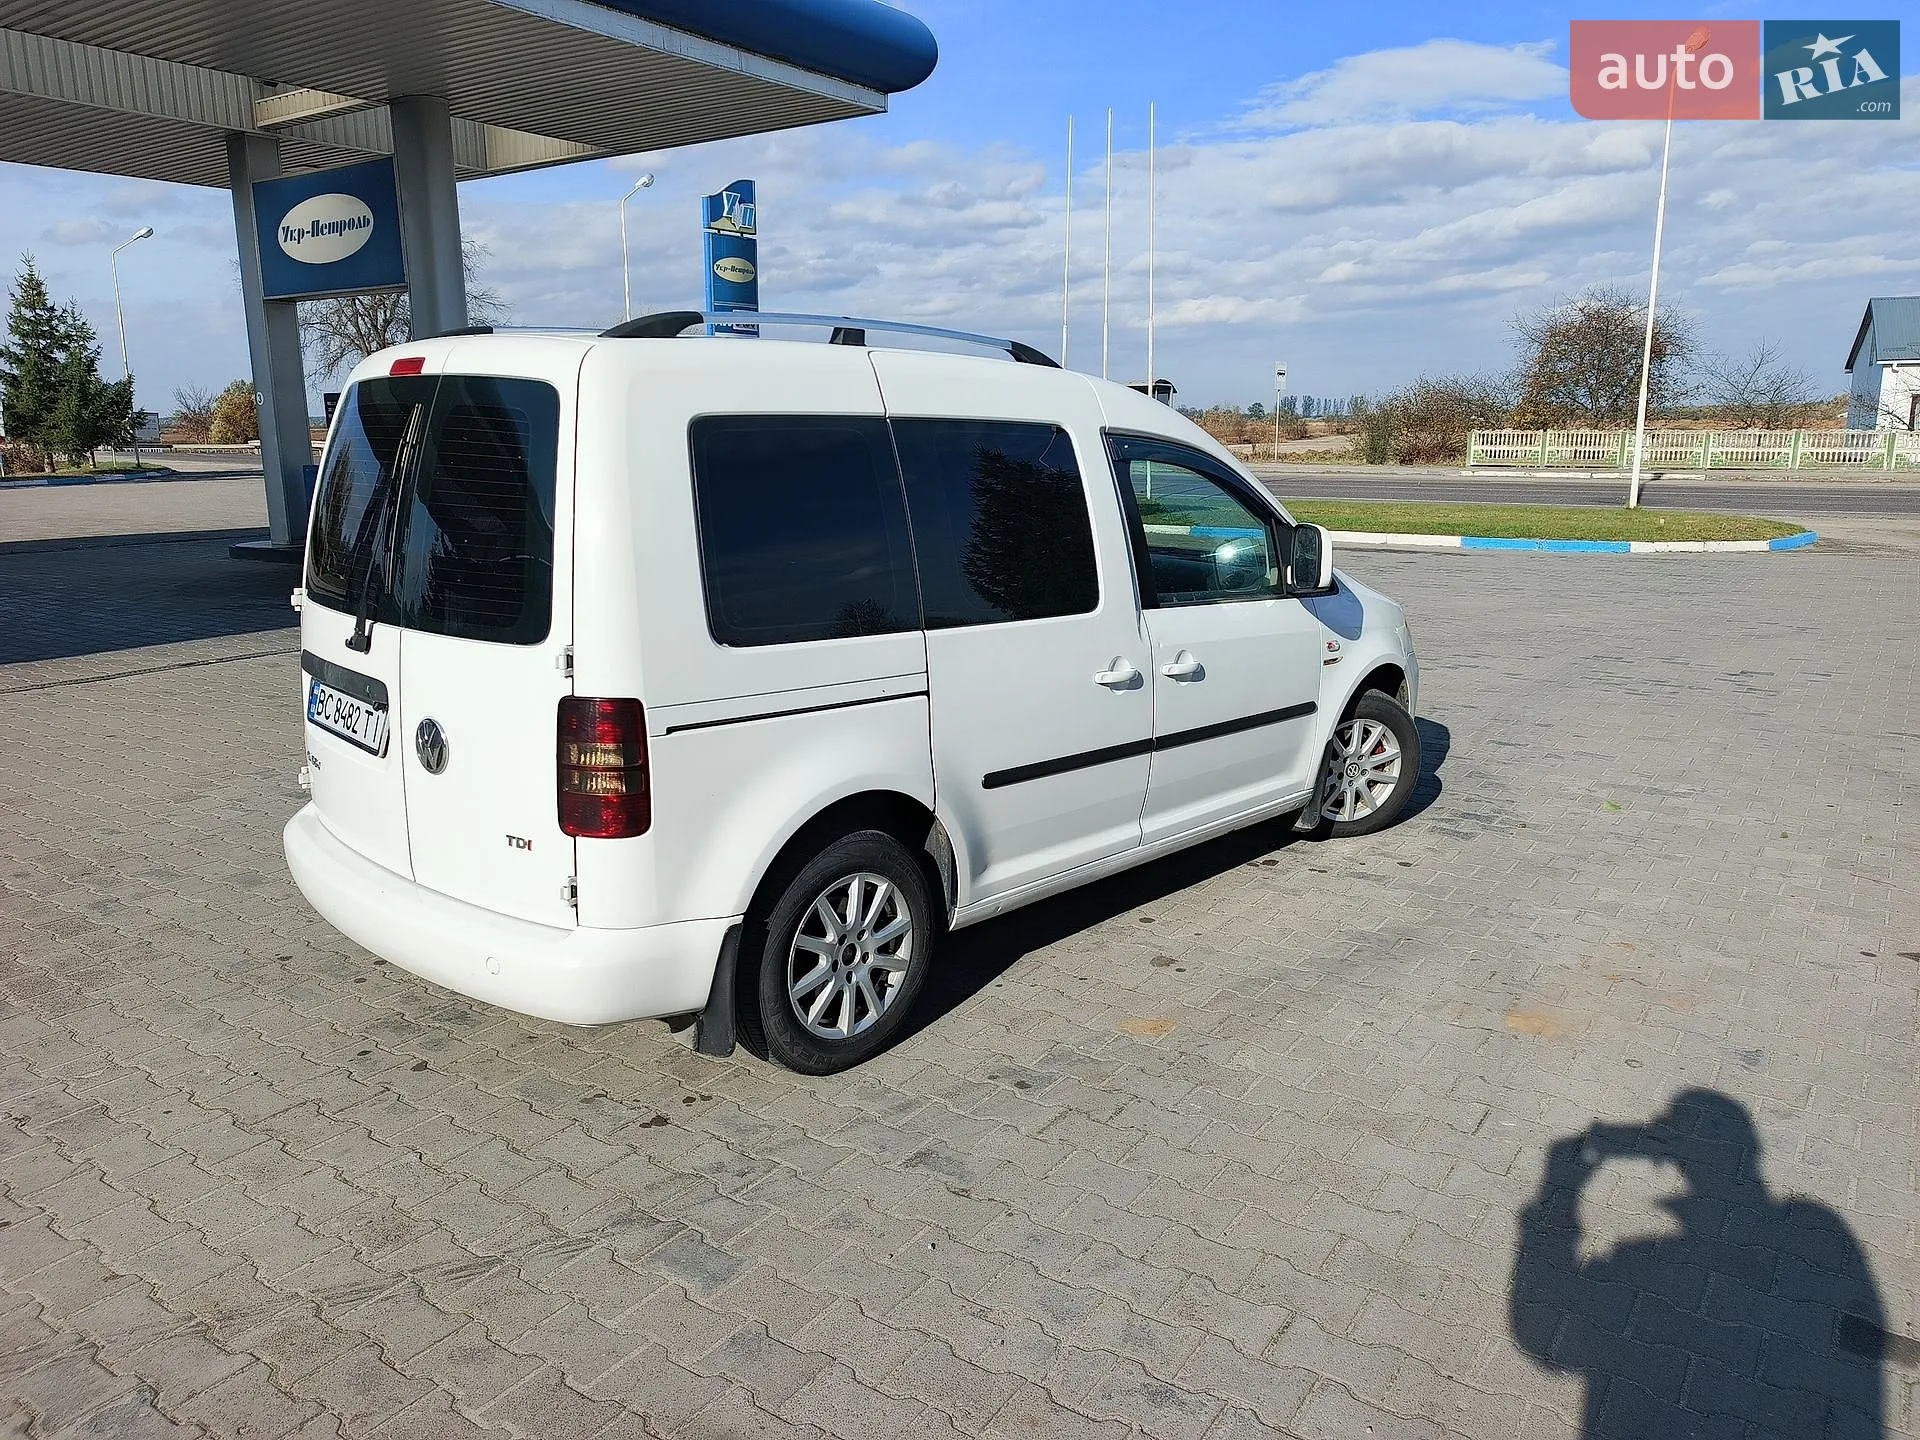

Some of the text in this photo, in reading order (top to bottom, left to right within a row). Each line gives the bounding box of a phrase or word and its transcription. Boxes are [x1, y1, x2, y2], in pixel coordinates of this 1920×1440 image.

[281, 215, 371, 245] Укр-Петроль
[316, 688, 333, 720] BC
[333, 697, 360, 735] 8482
